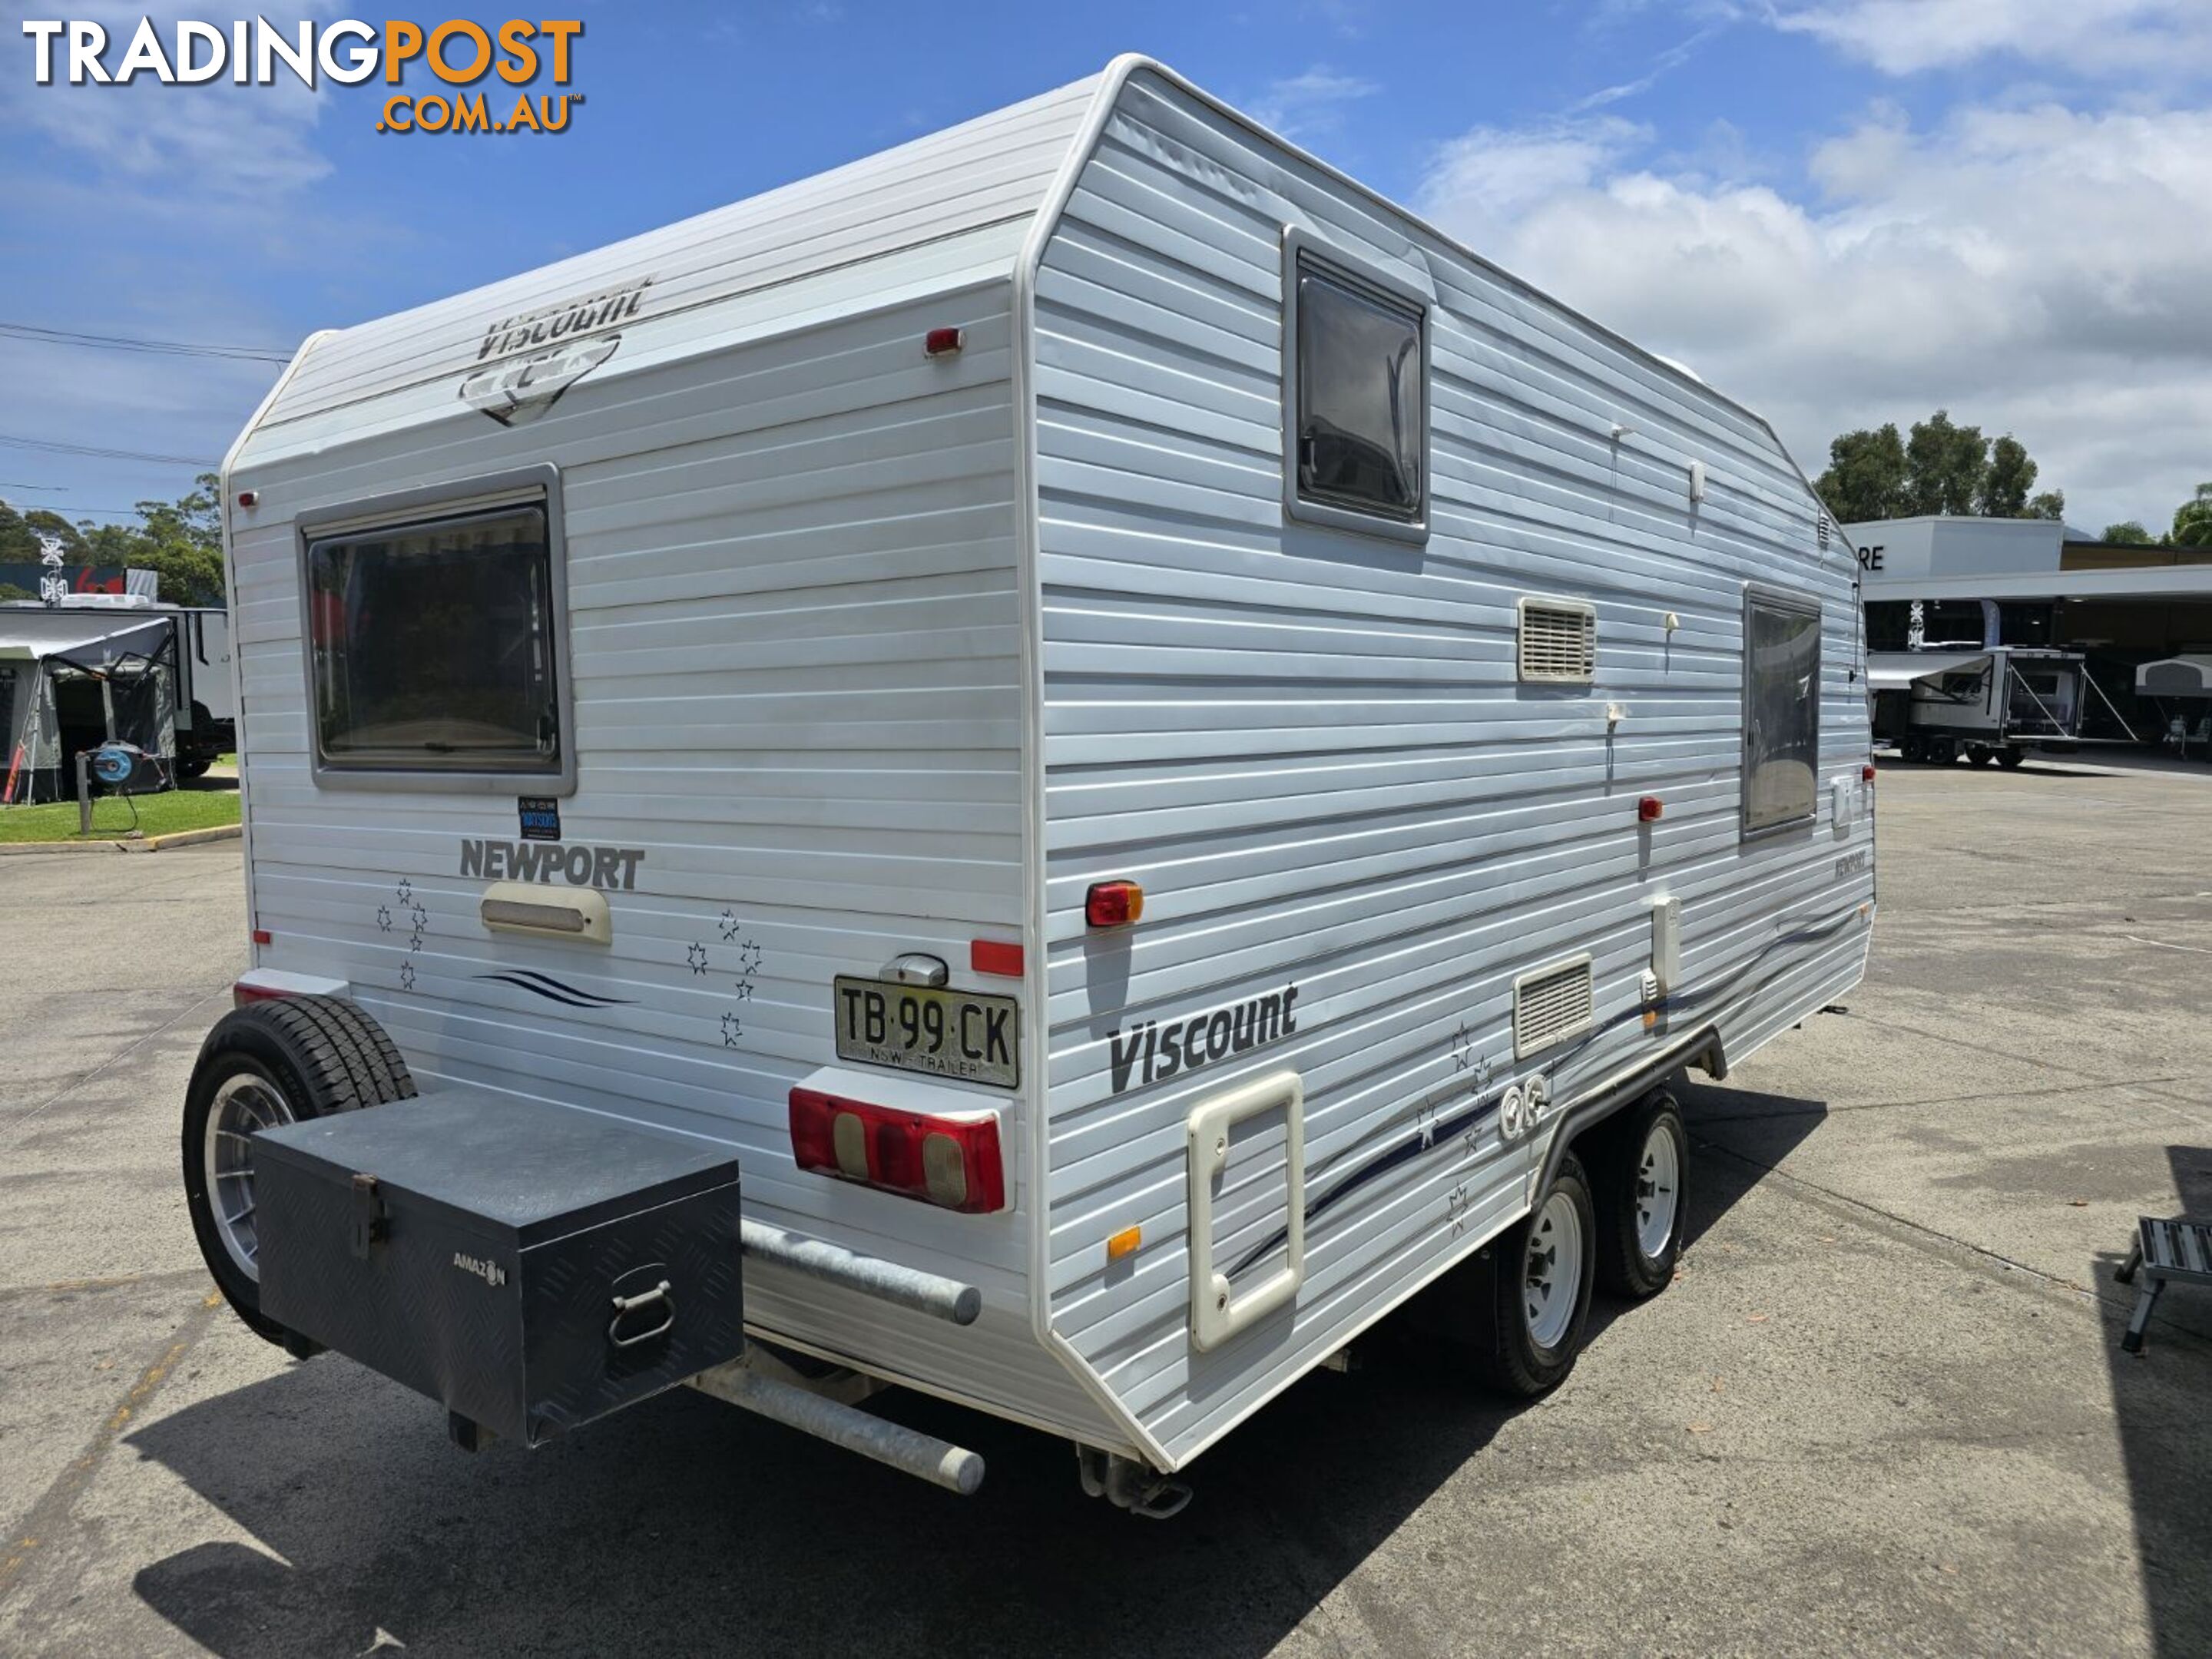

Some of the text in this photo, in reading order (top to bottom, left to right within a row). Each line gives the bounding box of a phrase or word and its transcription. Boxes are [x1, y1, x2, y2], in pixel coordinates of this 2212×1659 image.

[461, 839, 645, 890] NEWPORT
[871, 1047, 902, 1065] NSW
[920, 1055, 977, 1075] TRAILER
[1106, 981, 1298, 1094] Viscount
